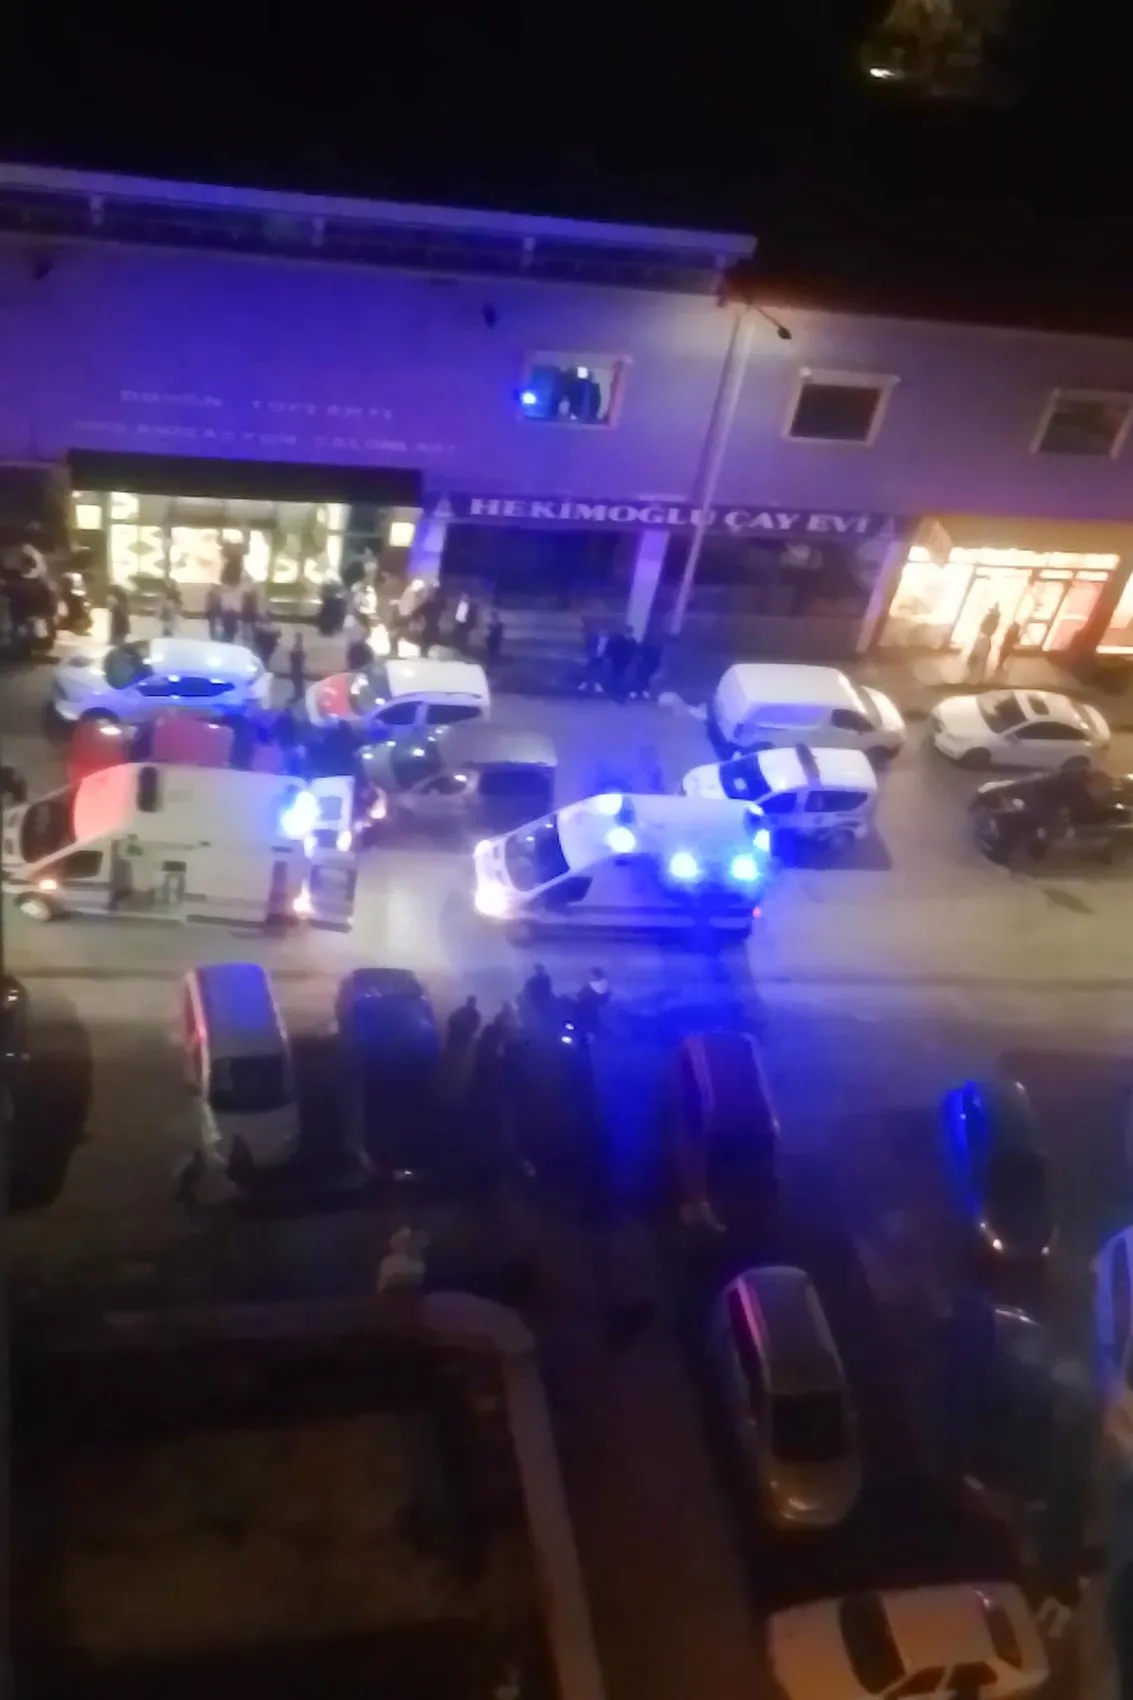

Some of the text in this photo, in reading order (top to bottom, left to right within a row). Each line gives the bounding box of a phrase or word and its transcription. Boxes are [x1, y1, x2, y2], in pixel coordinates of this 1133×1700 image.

[470, 498, 869, 533] HEKİMOĞLU ÇAY EVİ
